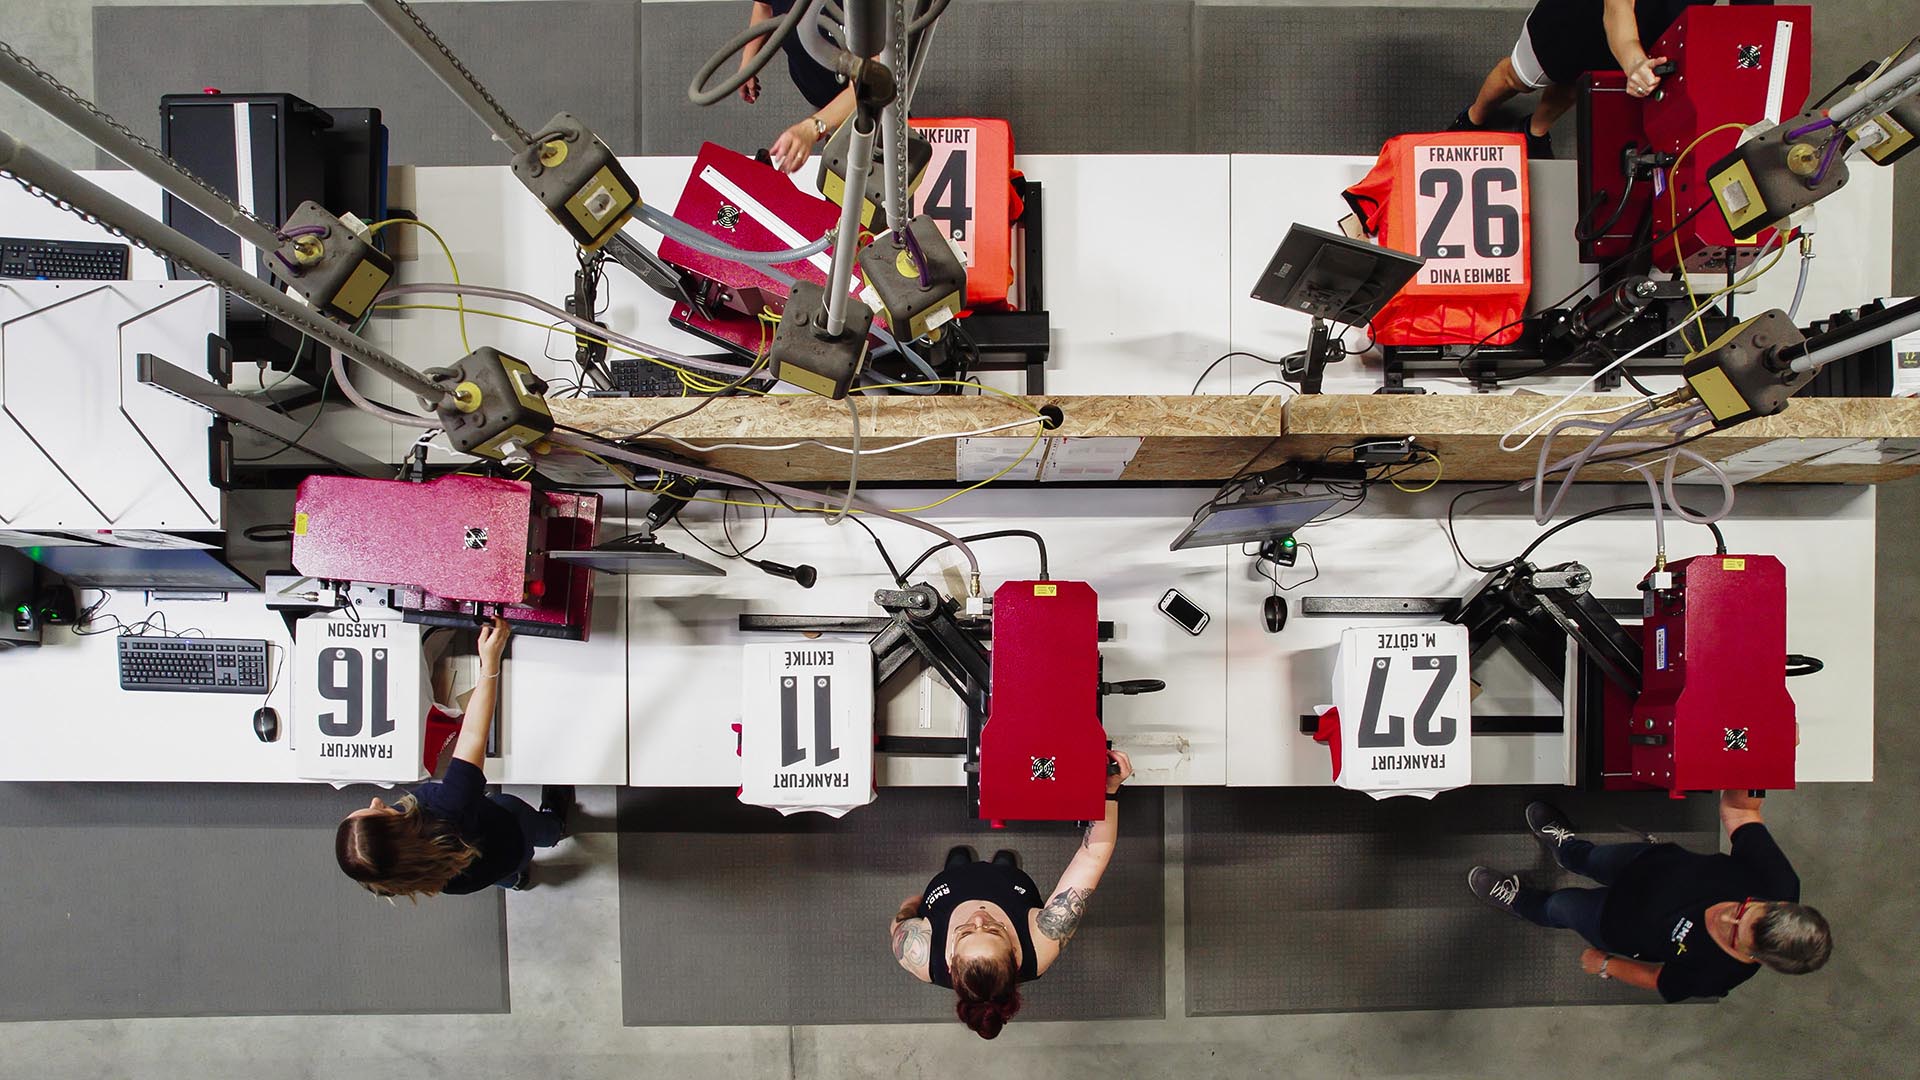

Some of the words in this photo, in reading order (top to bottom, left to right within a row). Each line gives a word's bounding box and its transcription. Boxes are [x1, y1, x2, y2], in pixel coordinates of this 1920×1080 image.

[912, 127, 970, 144] NKFURT
[1429, 146, 1504, 162] FRANKFURT
[908, 150, 973, 241] 4
[1419, 167, 1520, 259] 26
[1431, 269, 1461, 283] DINA
[1465, 268, 1511, 283] EBIMBE
[328, 623, 386, 638] LARSSON
[1377, 633, 1418, 651] GÖTZE
[1421, 632, 1436, 647] M.
[785, 651, 834, 669] EKITIKÉ
[318, 647, 395, 738] 16
[1358, 655, 1457, 749] 27
[781, 675, 840, 768] 11
[320, 743, 393, 759] FRANKFURT
[1371, 754, 1446, 770] FRANKFURT
[773, 773, 849, 788] FRANKFURT
[929, 887, 950, 904] RMD
